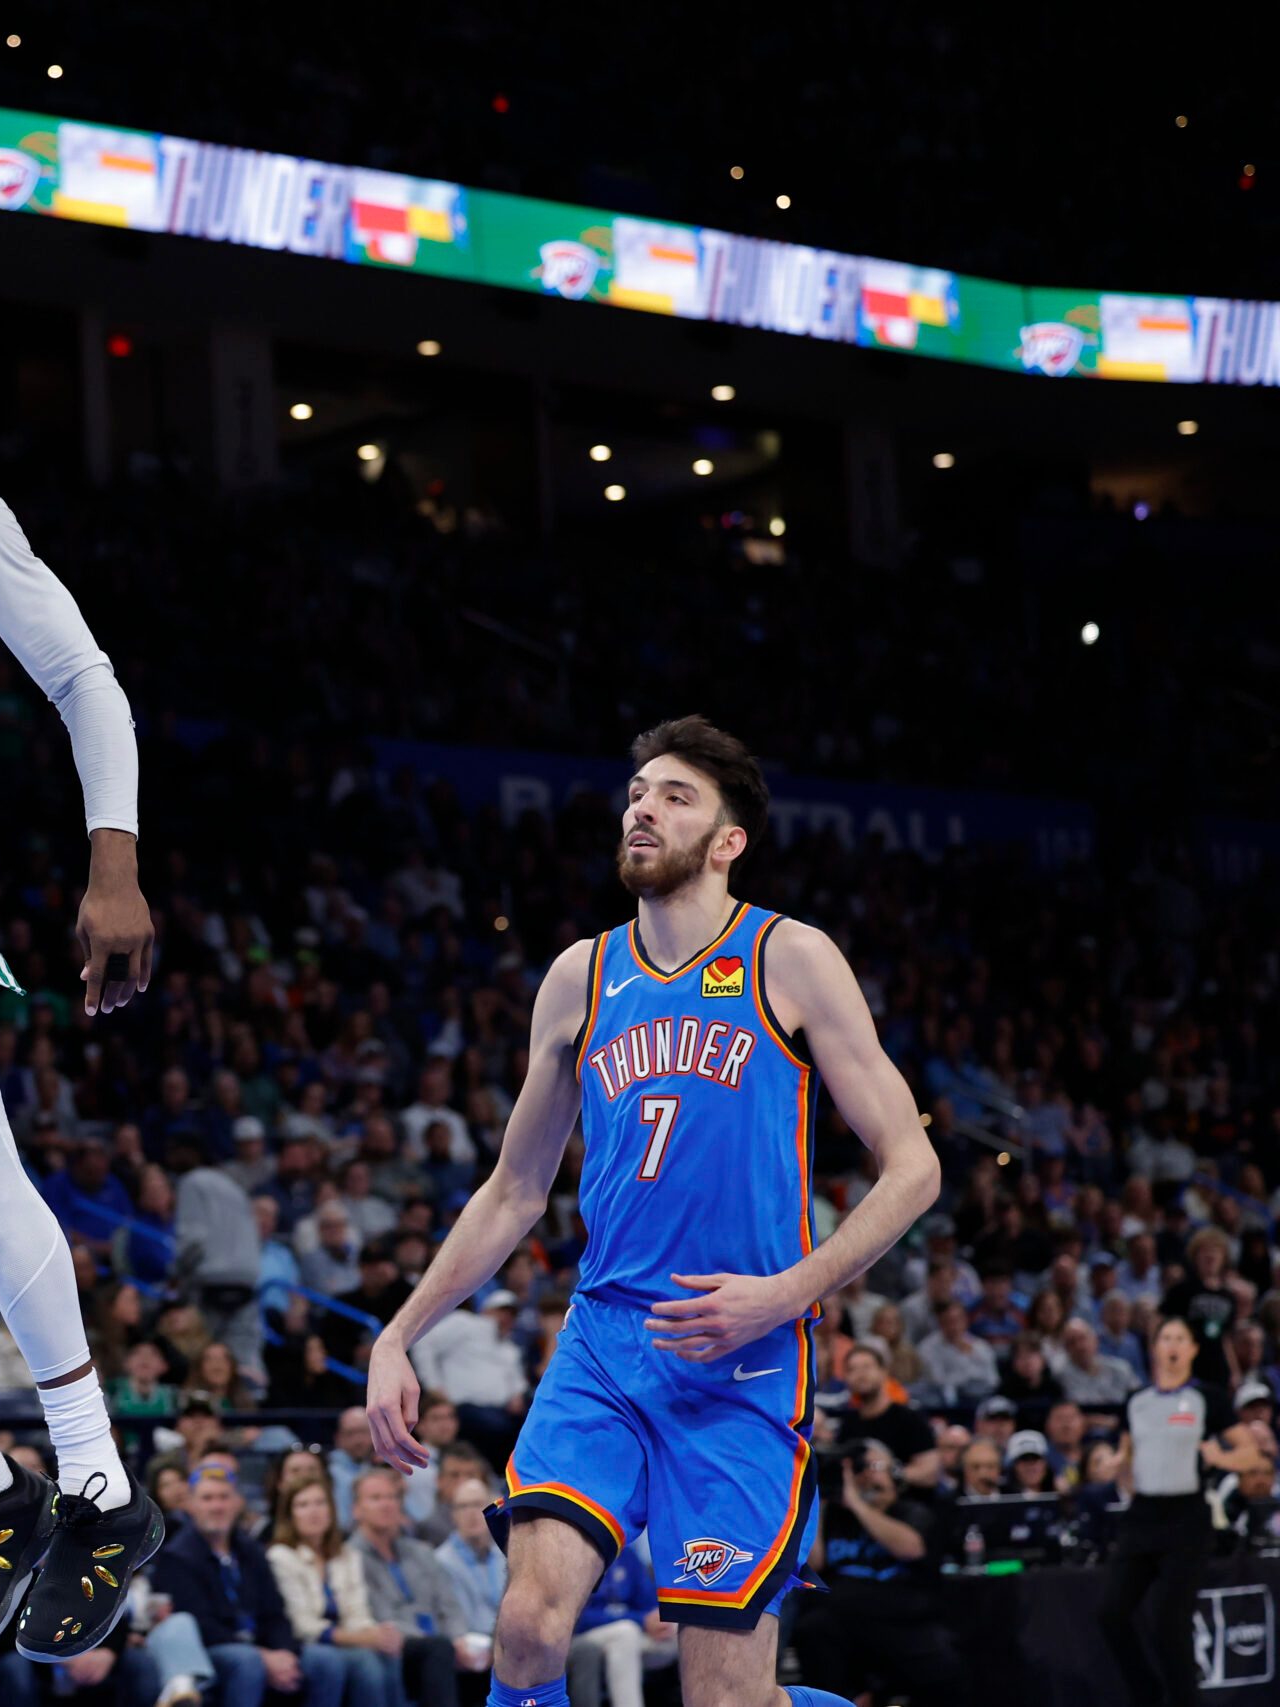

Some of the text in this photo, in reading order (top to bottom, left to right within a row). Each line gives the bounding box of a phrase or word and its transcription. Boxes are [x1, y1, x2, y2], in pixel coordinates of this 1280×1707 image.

[161, 134, 352, 260] THUNDER
[589, 1016, 755, 1101] THUNDER
[637, 1095, 680, 1181] 7
[686, 1549, 724, 1573] OKC
